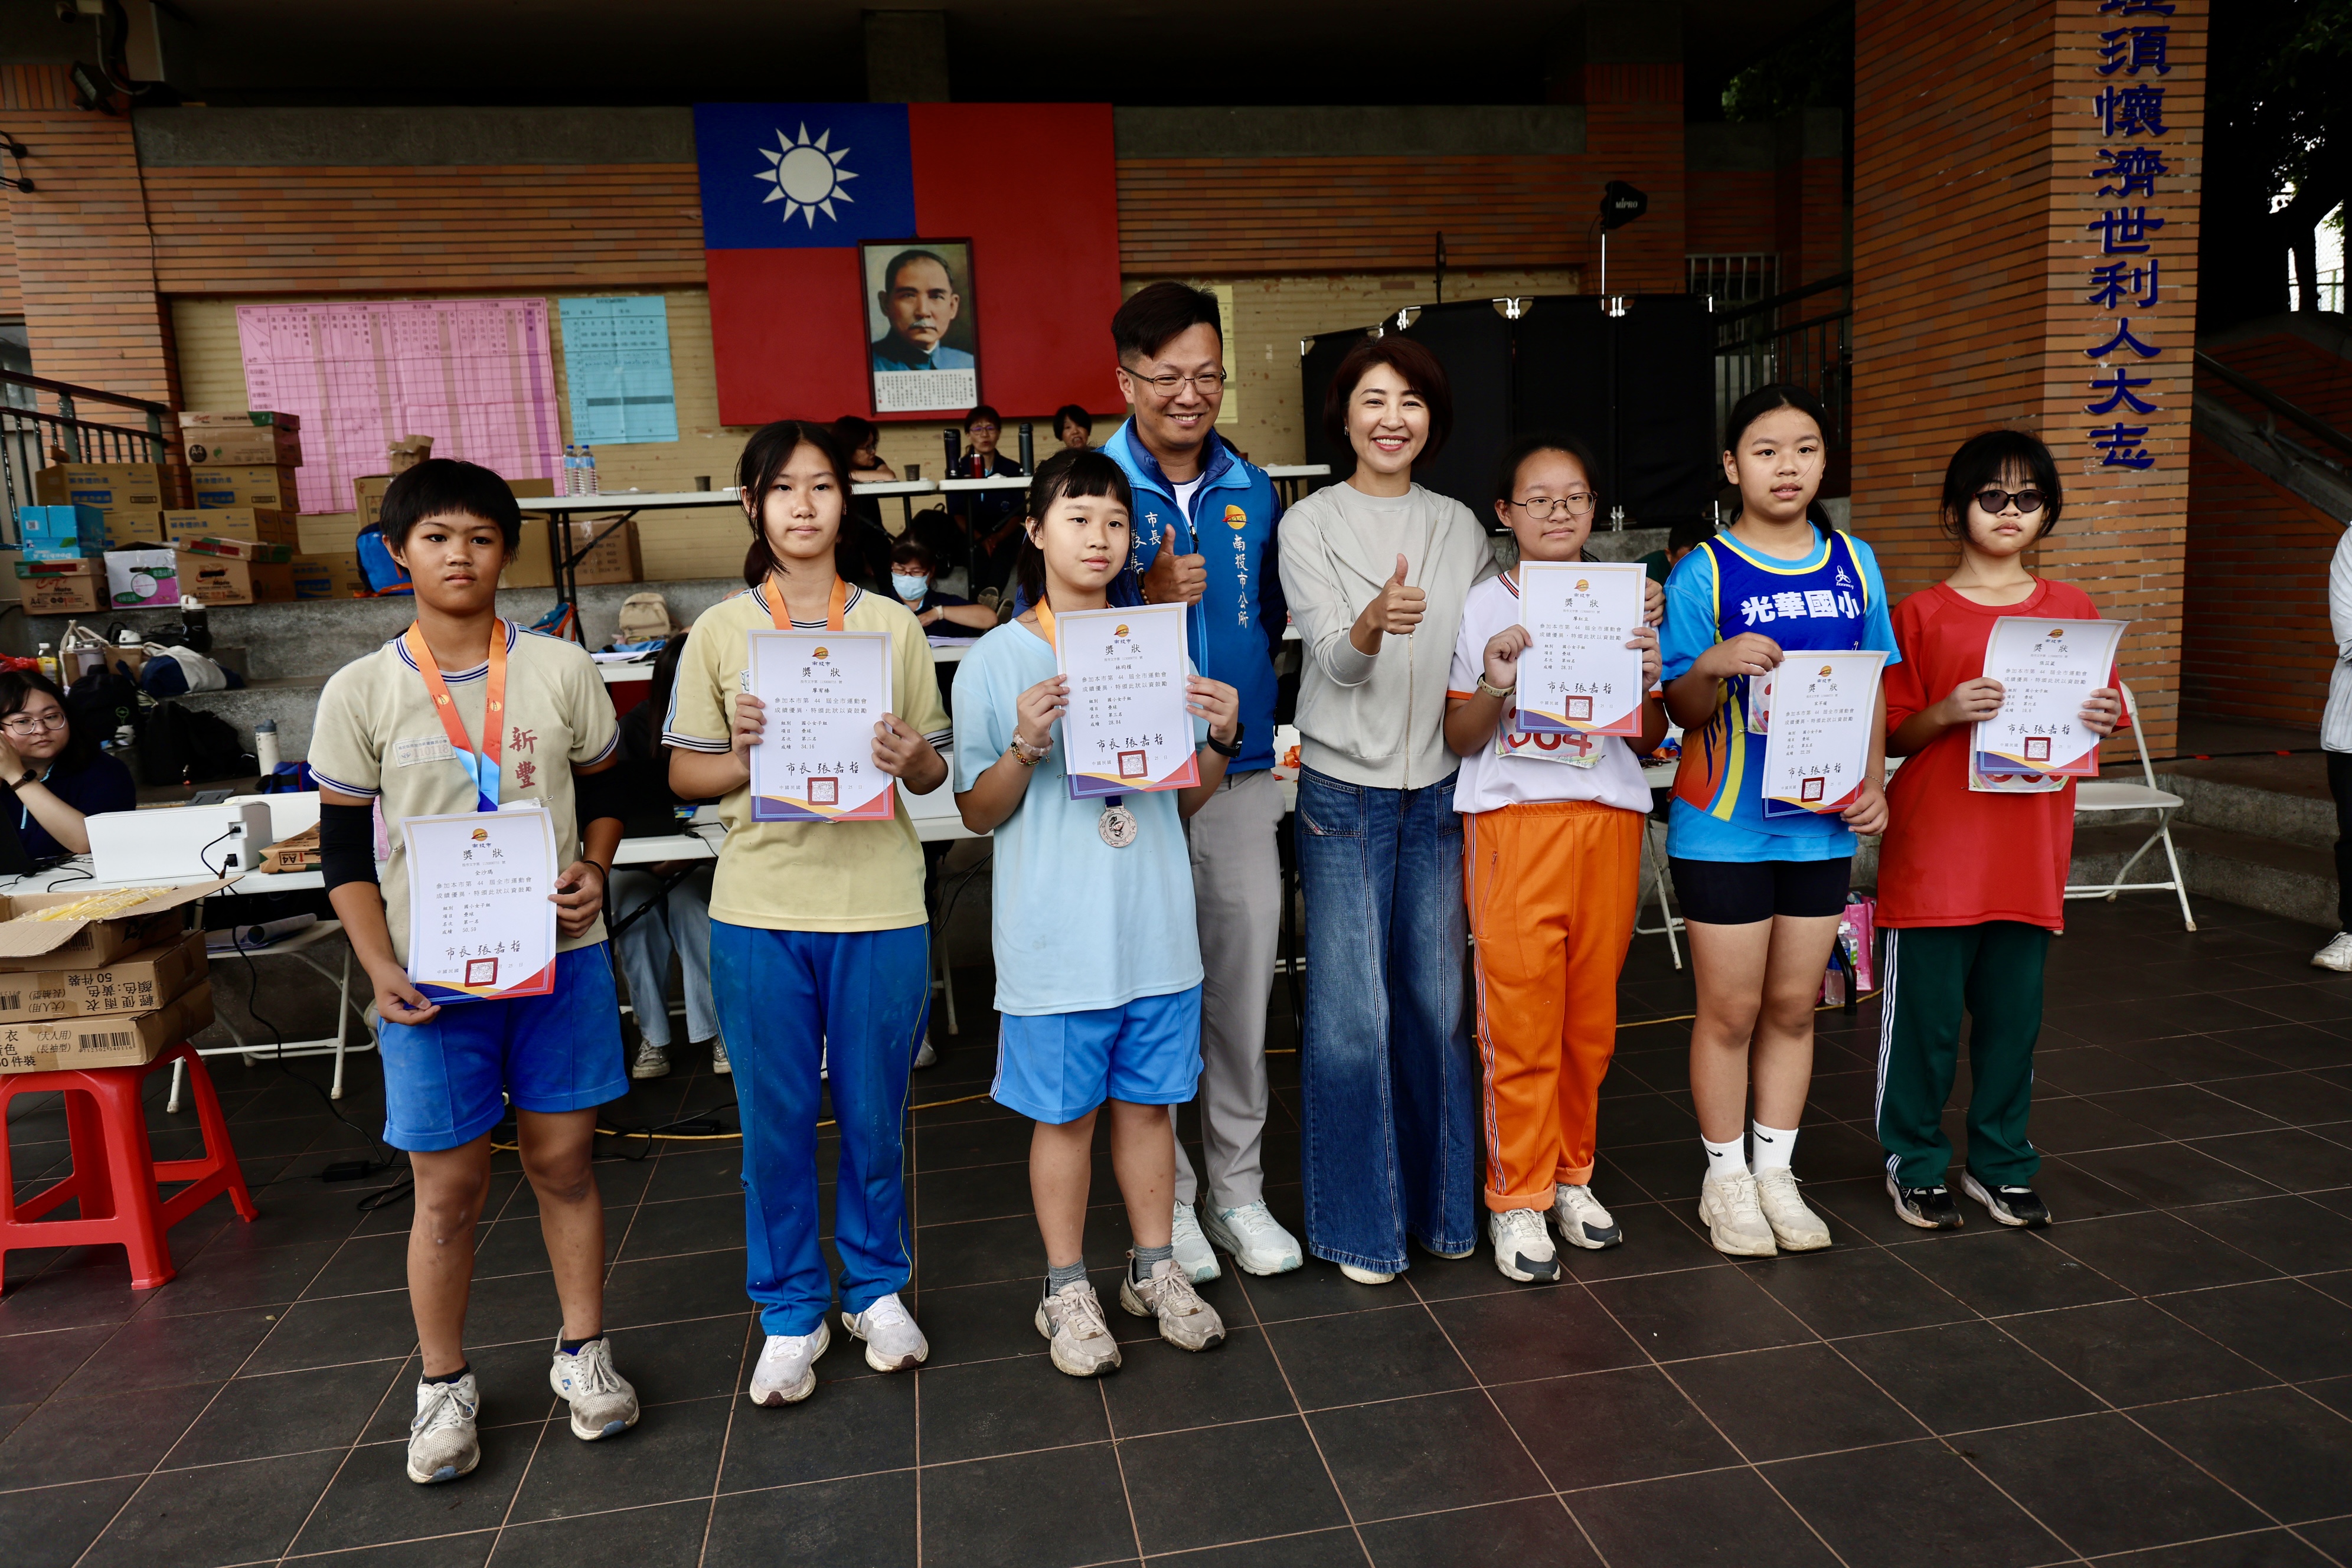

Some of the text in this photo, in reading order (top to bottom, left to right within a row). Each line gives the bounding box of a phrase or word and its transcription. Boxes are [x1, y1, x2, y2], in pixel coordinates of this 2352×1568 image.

[1145, 511, 1161, 545] 市長
[1232, 534, 1249, 629] 南投市公所
[1740, 590, 1860, 627] 光華國小
[1105, 643, 1141, 655] 獎 狀
[802, 667, 841, 677] 獎 狀
[1082, 675, 1113, 683] 參加本市第
[509, 727, 538, 789] 新豐
[463, 848, 504, 860] 獎 狀
[436, 880, 472, 890] 參加本市第
[68, 973, 112, 987] 50 件裝
